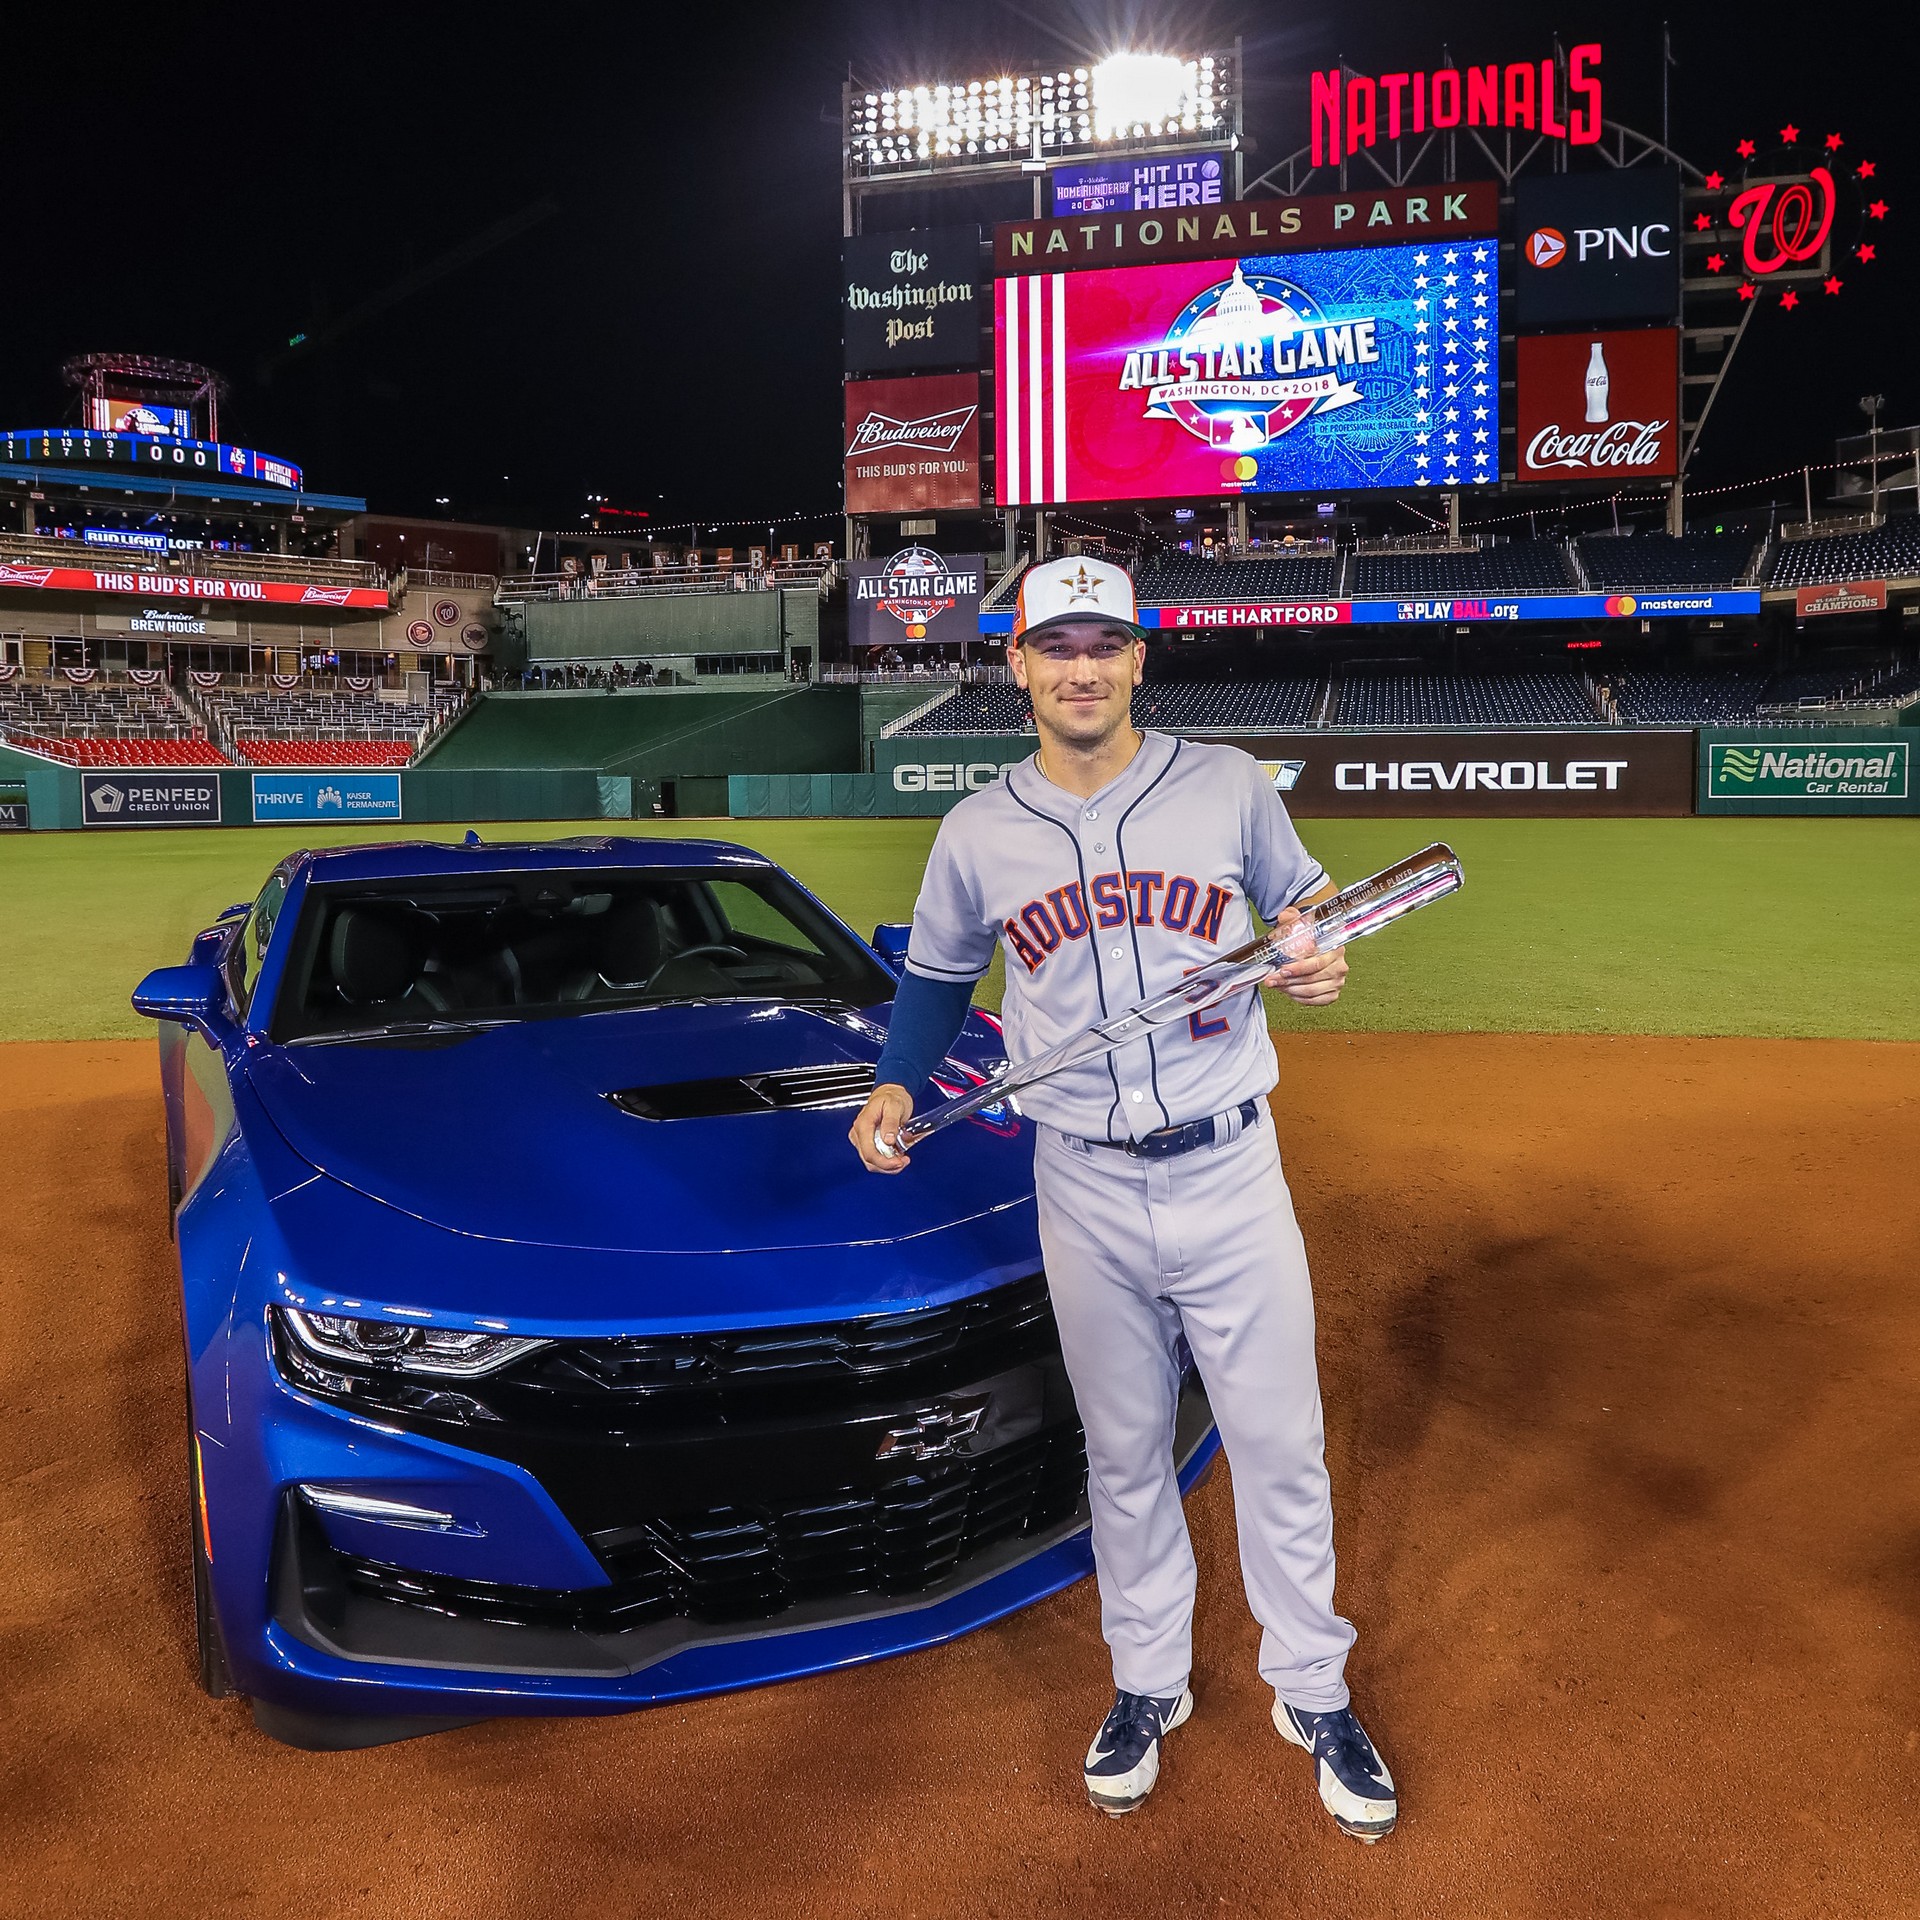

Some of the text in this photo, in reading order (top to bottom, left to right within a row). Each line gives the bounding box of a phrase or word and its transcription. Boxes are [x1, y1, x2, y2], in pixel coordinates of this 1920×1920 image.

[1311, 43, 1601, 168] NATIONALS
[1134, 162, 1198, 184] HIT IT
[1056, 184, 1081, 200] HOME
[1101, 181, 1130, 195] DERBY
[1134, 179, 1221, 211] HERE
[1012, 193, 1469, 257] NATIONALS PARK
[1728, 166, 1836, 275] W
[1574, 223, 1670, 262] PNC
[890, 248, 929, 277] The
[847, 280, 973, 311] Washington
[886, 315, 934, 349] Post
[1119, 350, 1174, 391] ALL
[1180, 343, 1270, 383] STAR
[1273, 322, 1380, 375] GAME
[1158, 379, 1329, 399] WASHINGTON, DC 2018
[1356, 382, 1399, 401] EAGUE
[84, 430, 89, 438] E
[102, 431, 118, 439] LOB
[856, 421, 964, 445] Budweiser
[1330, 422, 1377, 432] PROFESSIONAL
[1379, 420, 1409, 430] BASEBALL
[8, 441, 13, 449] 3
[61, 438, 73, 447] 13
[84, 440, 90, 448] 0
[107, 440, 114, 449] 9
[176, 438, 182, 446] S
[1526, 420, 1669, 469] Coca-Cola
[9, 448, 114, 459] 1 6 7 1 7
[150, 445, 206, 466] 0 0 0
[230, 450, 246, 465] ASG
[265, 460, 292, 478] AMERICAN
[856, 460, 968, 478] THIS BUD'S FOR YOU.
[265, 470, 293, 489] NATIONAL
[87, 532, 204, 549] BUD LIGHT LOFT
[94, 572, 267, 600] THIS BUD'S FOR YOU.
[304, 590, 347, 600] Budweiser
[857, 575, 977, 599] ALL STAR GAME
[1641, 597, 1712, 610] mastercard
[1805, 598, 1878, 612] CHAMPIONS
[143, 608, 194, 621] Budweiser
[1192, 605, 1338, 625] THE HARTFORD
[131, 620, 206, 634] BREW HOUSE
[1759, 752, 1896, 779] National
[1335, 761, 1628, 791] CHEVROLET
[128, 787, 210, 802] PENFED
[346, 792, 372, 801] KAISER
[1806, 782, 1888, 794] Car Rental
[128, 802, 210, 812] CREDIT UNION
[256, 793, 304, 805] THRIVE
[346, 800, 398, 809] PERMANENTE
[1326, 881, 1374, 909] TED WILLIAMS
[1328, 868, 1414, 916] MOST VALUABLE PLAYER
[1003, 870, 1234, 975] HOUSTON
